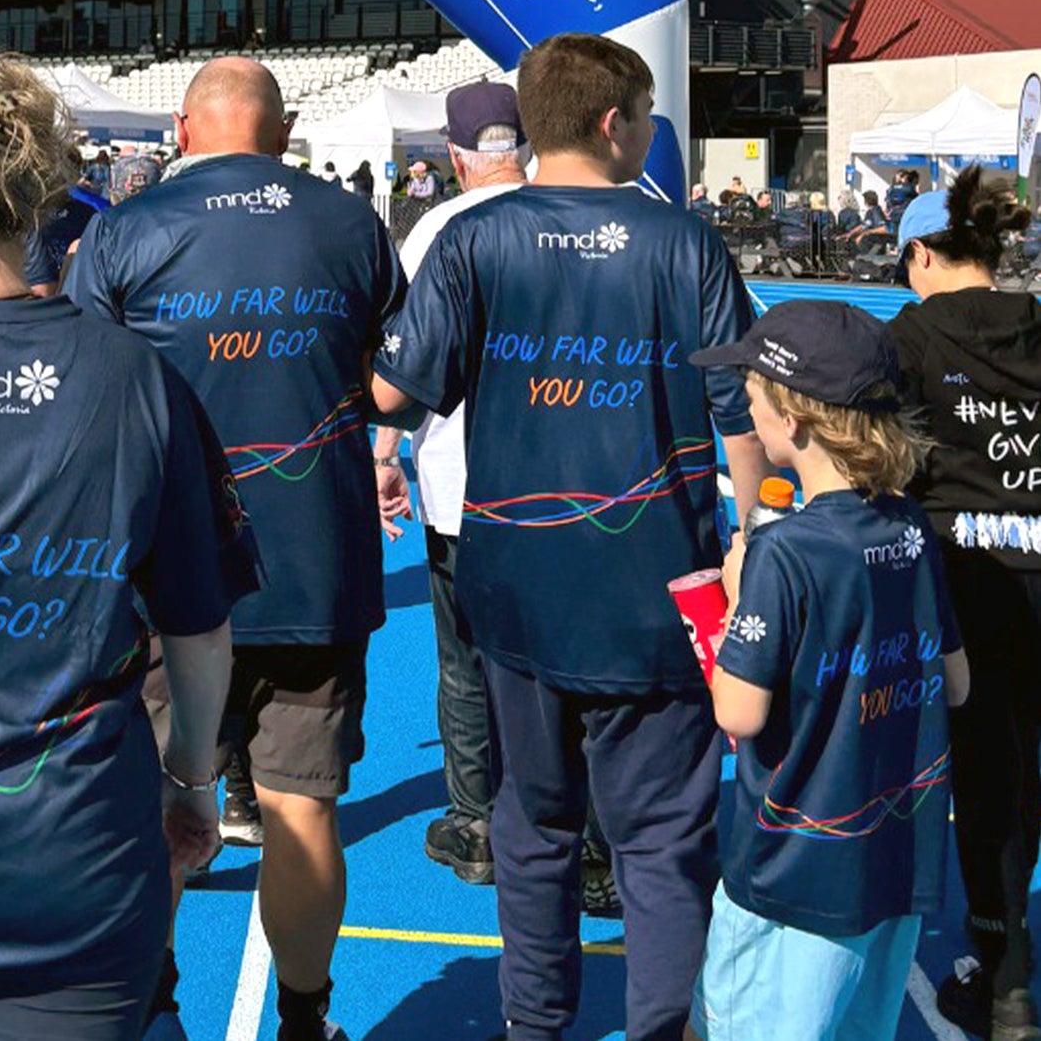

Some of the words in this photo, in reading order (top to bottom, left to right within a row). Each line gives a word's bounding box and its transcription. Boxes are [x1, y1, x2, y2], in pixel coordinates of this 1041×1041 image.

[206, 188, 261, 210] mnd
[538, 229, 594, 249] mnd
[156, 290, 222, 323] HOW
[230, 286, 285, 316] FAR
[208, 330, 261, 362] YOU
[268, 327, 318, 358] GO?
[484, 331, 545, 362] HOW
[551, 336, 607, 366] FAR
[616, 338, 679, 369] WIL
[528, 377, 584, 407] YOU
[588, 379, 644, 409] GO?
[31, 534, 131, 581] WILL
[864, 537, 903, 565] mnd
[894, 675, 943, 711] GO?
